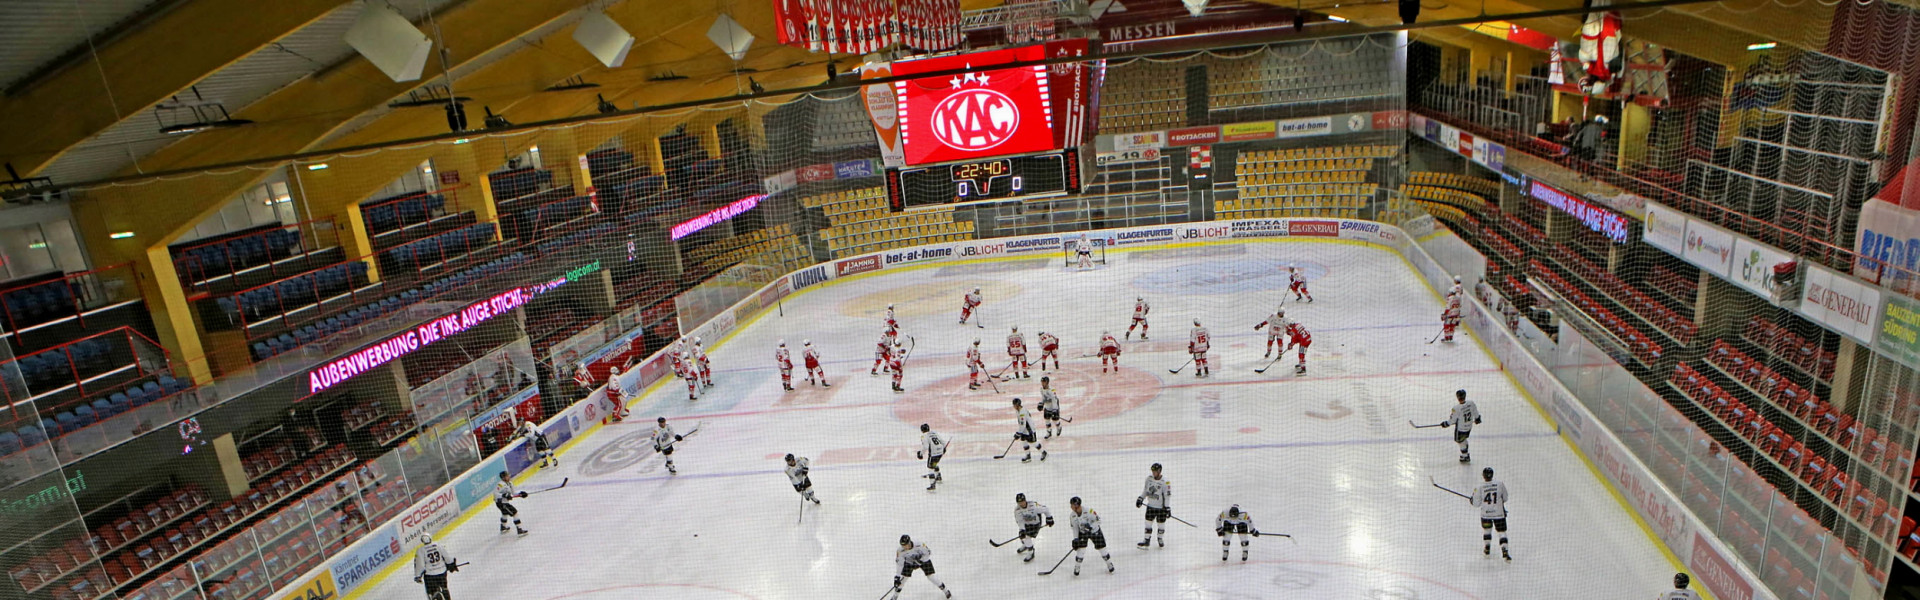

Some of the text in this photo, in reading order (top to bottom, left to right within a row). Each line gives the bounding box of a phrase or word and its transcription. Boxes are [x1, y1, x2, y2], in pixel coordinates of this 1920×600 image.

[1110, 21, 1176, 41] MESSEN
[1073, 49, 1084, 113] #ROTJACKN
[937, 92, 1013, 148] KAC
[1282, 121, 1329, 132] bet-at-home
[960, 161, 1002, 178] 22:40
[959, 182, 968, 197] 0
[1012, 176, 1022, 191] 0
[1117, 228, 1174, 240] KLAGENFURTER
[1302, 223, 1338, 233] GENERALI
[1340, 221, 1380, 234] SPRINGER
[1005, 237, 1061, 249] KLAGENFURTER
[886, 247, 952, 265] bet-at-home
[1822, 288, 1872, 326] GENERALI
[420, 326, 441, 346] DIE
[441, 314, 461, 336] INS
[462, 306, 491, 332] AUGE
[1198, 335, 1206, 344] 15
[1463, 411, 1472, 423] 12
[1484, 491, 1498, 505] 41
[401, 489, 454, 533] ROSCOM
[427, 551, 441, 564] 33
[338, 545, 393, 590] SPARKASSE
